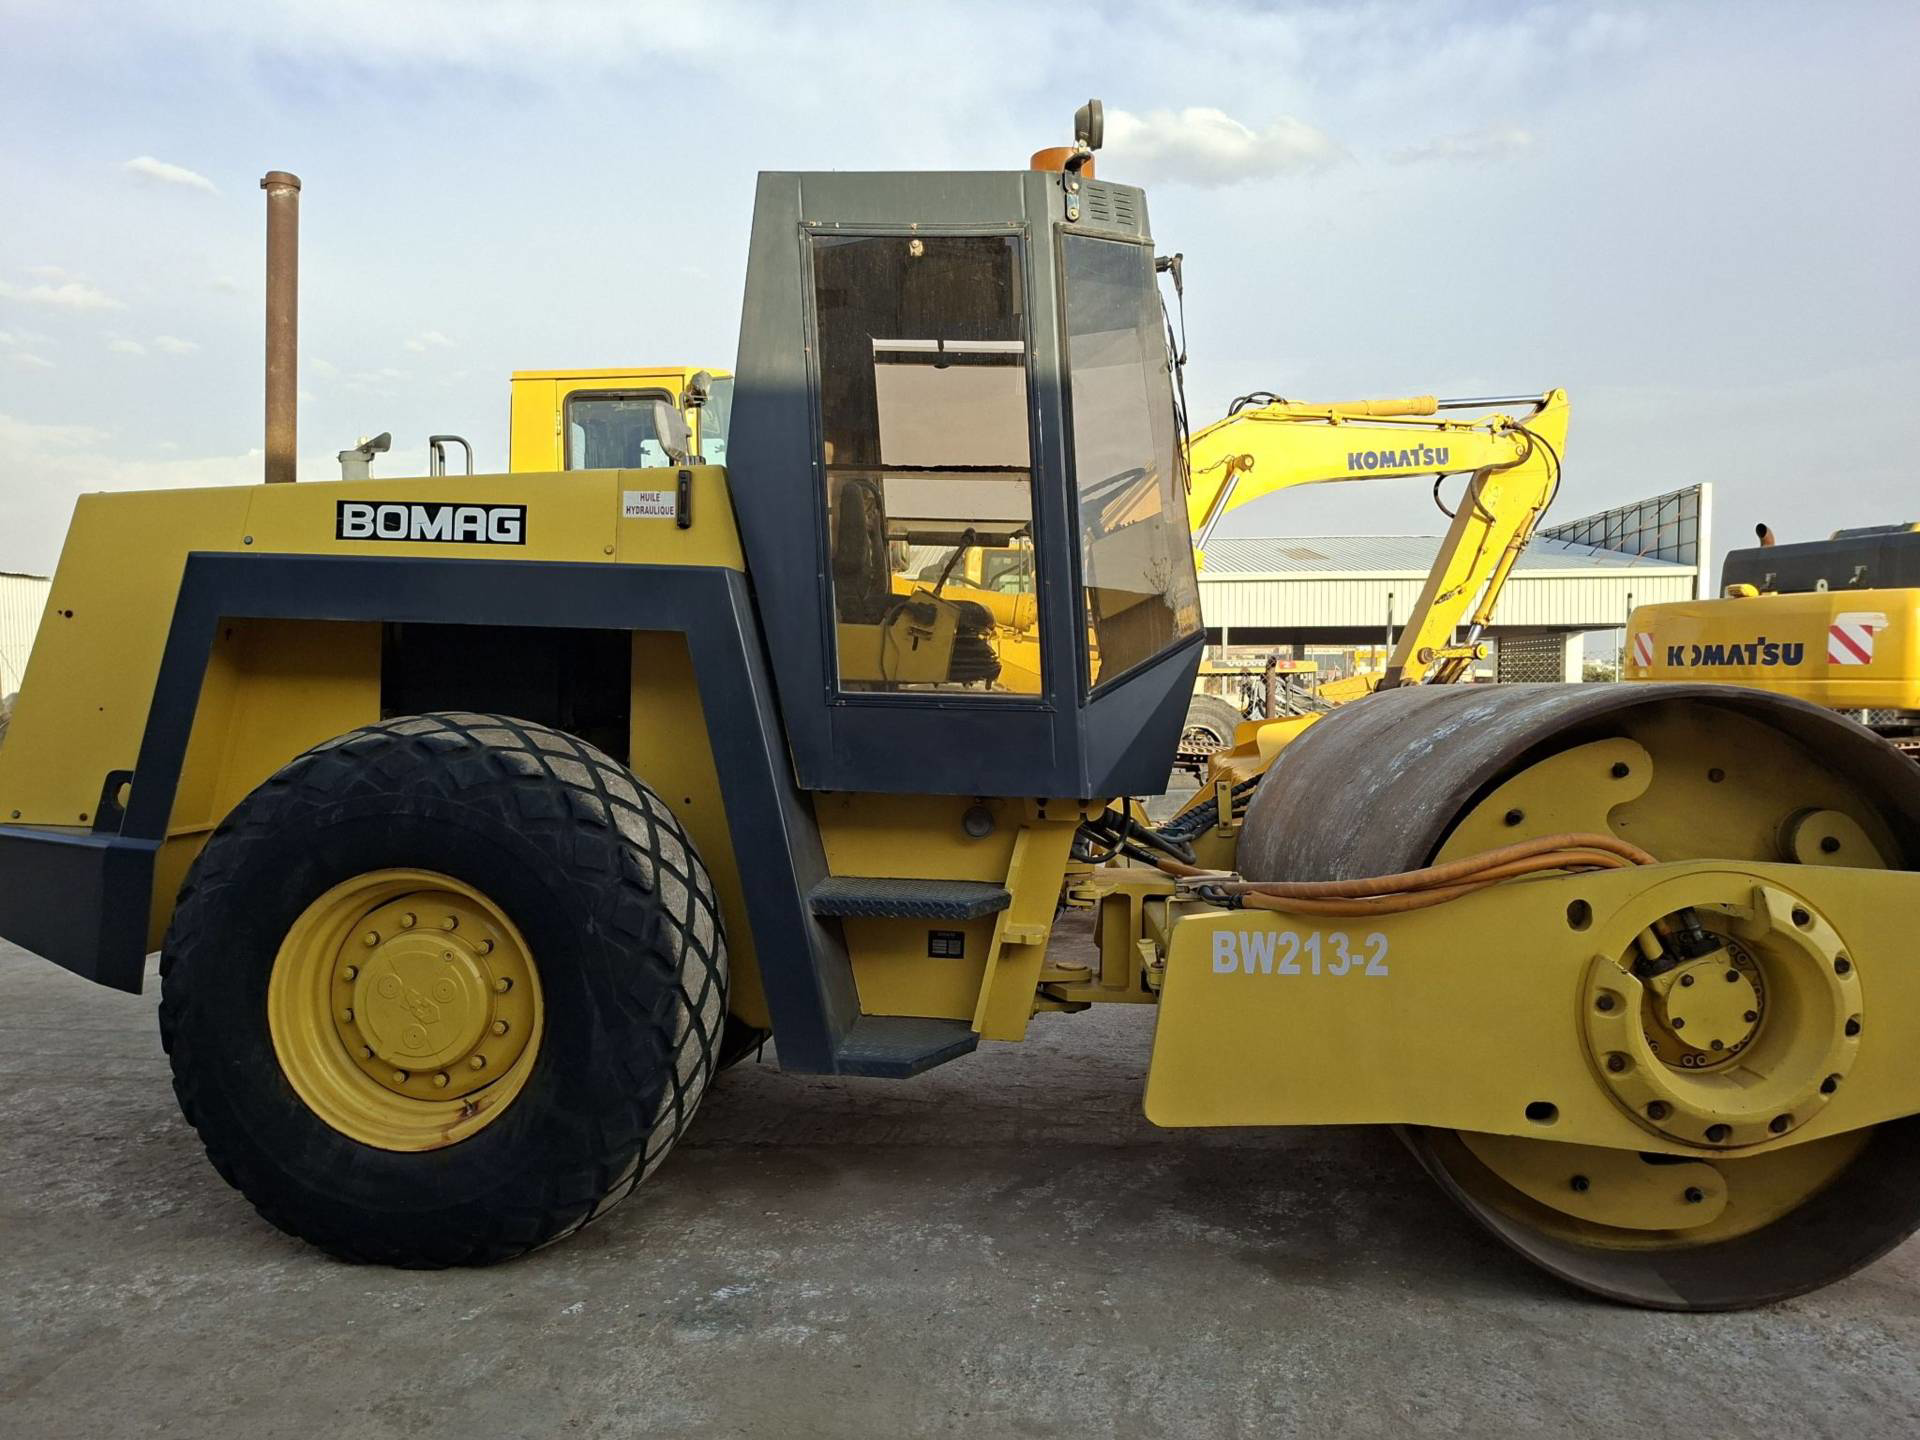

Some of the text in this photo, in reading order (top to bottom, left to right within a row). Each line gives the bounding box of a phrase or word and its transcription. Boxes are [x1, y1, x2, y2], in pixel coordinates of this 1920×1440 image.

[1347, 443, 1449, 470] KOMATSU
[626, 505, 674, 515] HYDRAULIQUE
[640, 493, 661, 502] HUILE
[342, 503, 521, 542] BOMAG
[1212, 930, 1389, 976] BW213-2
